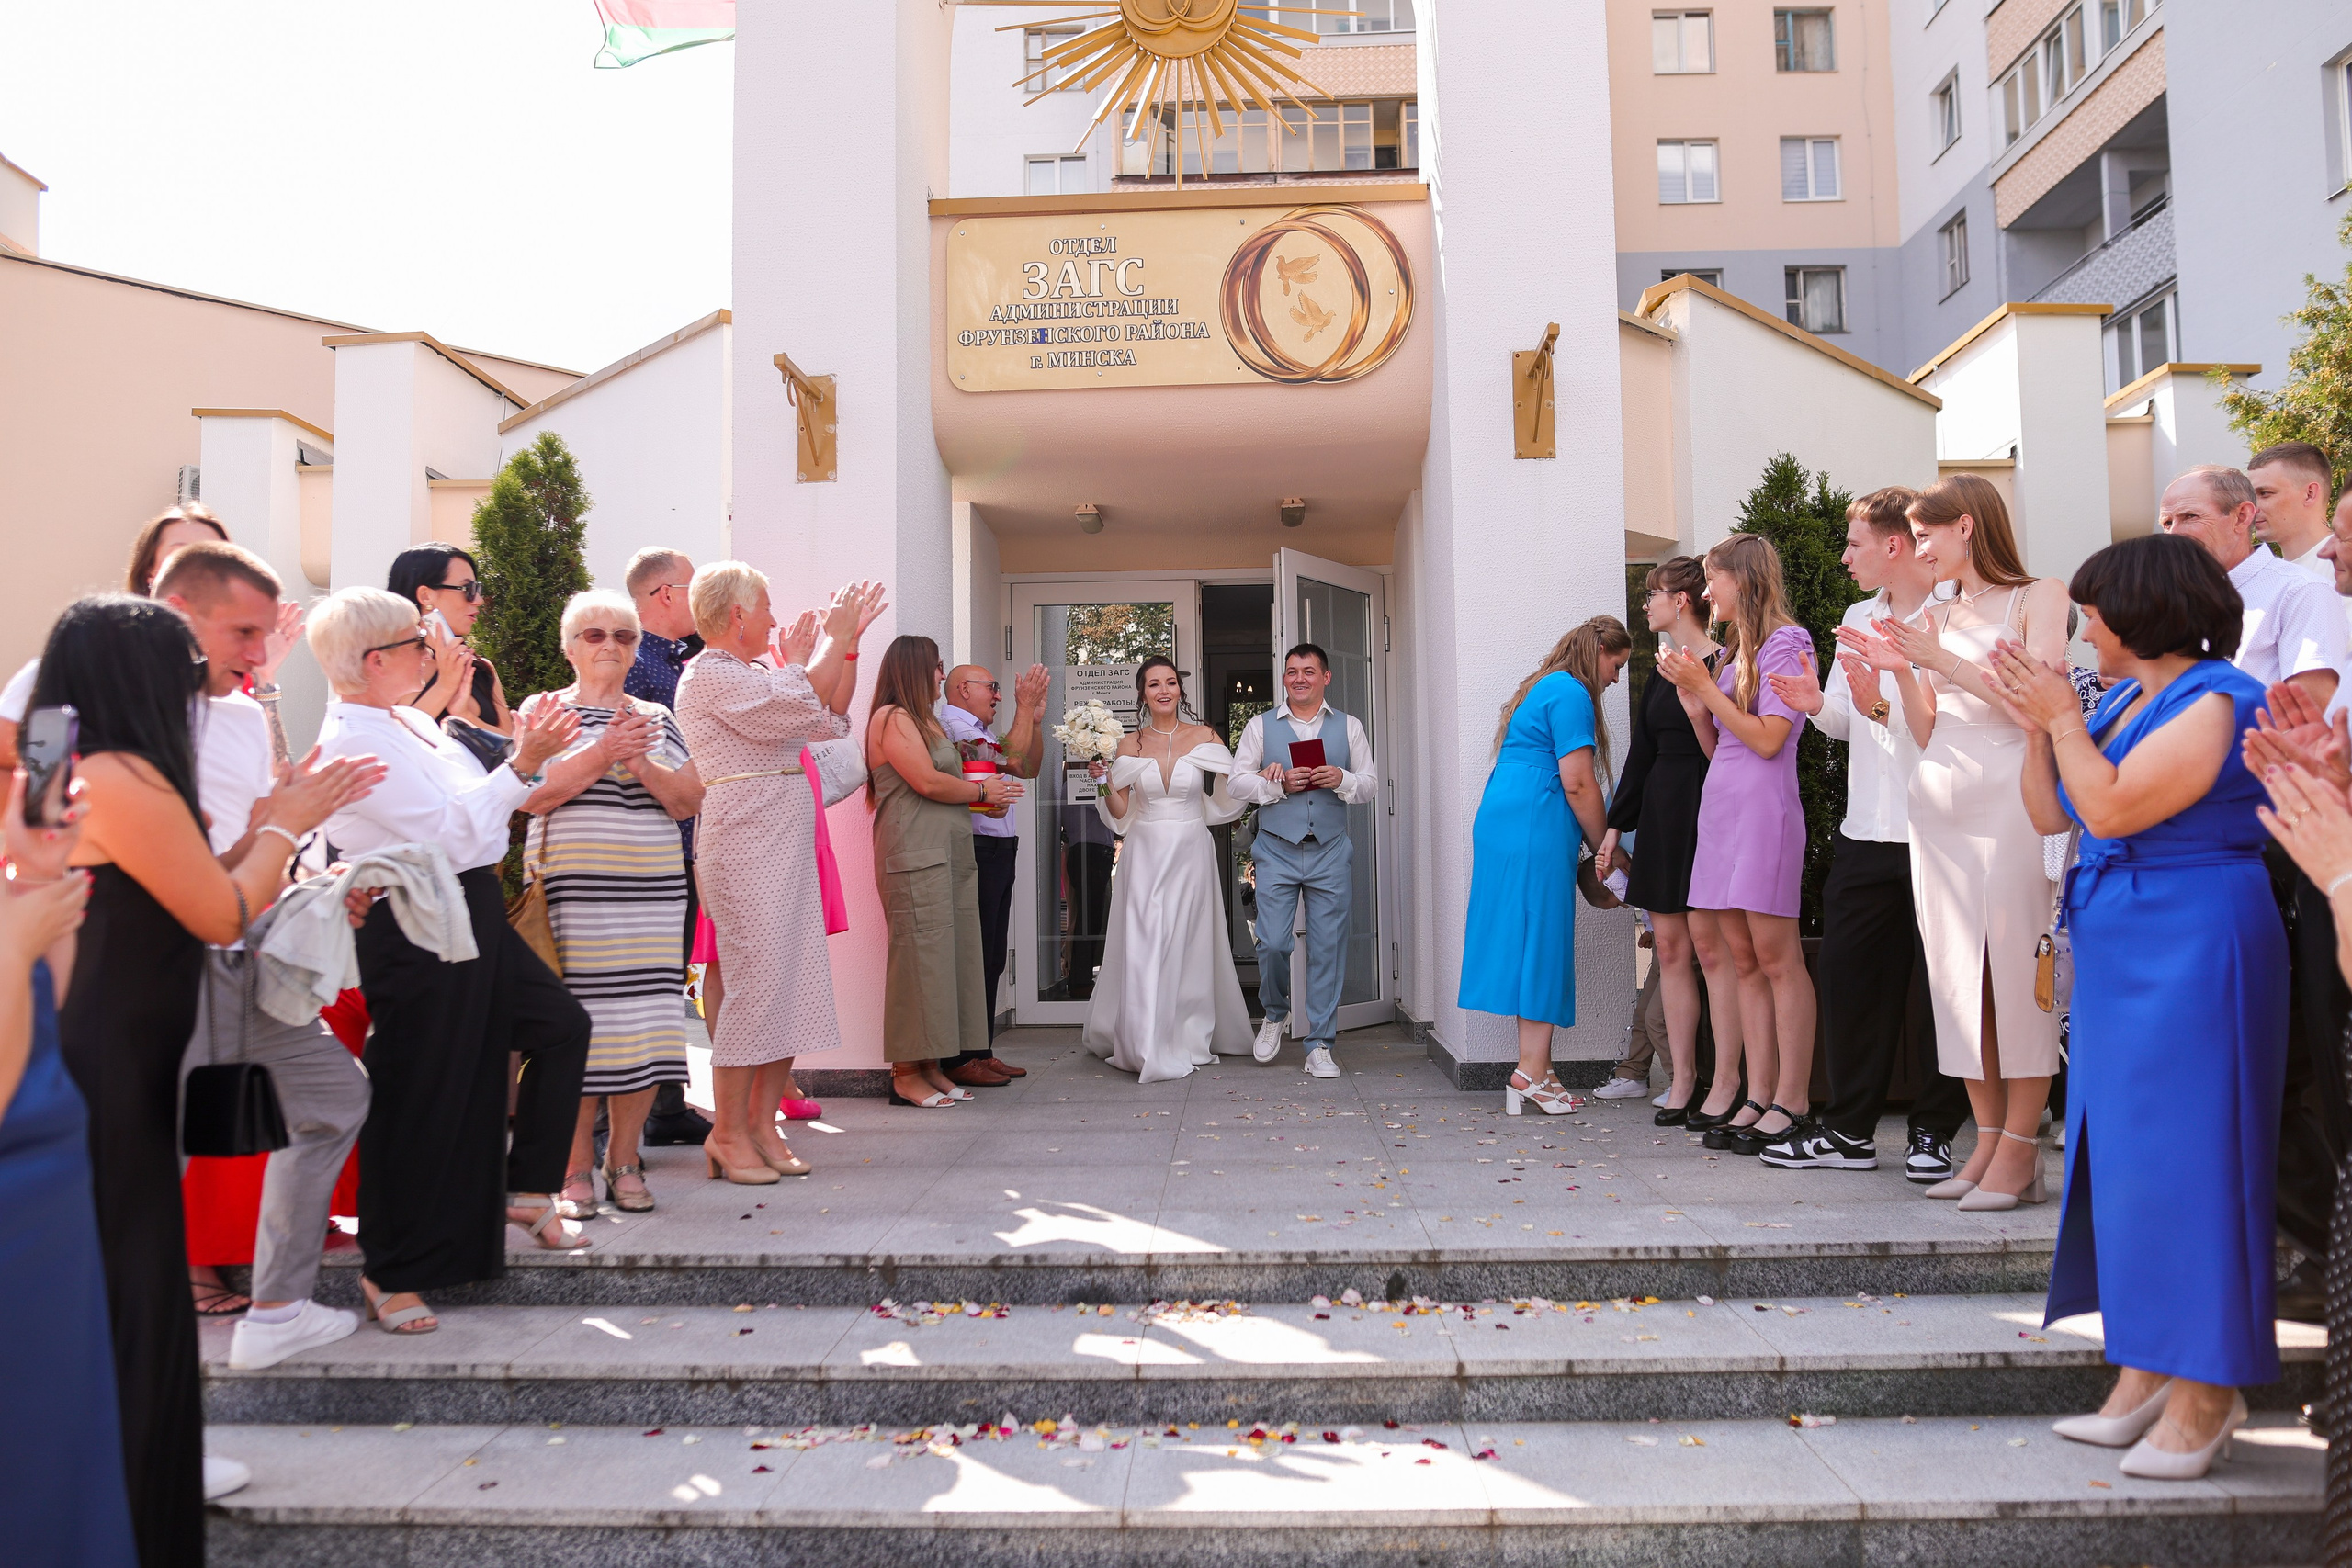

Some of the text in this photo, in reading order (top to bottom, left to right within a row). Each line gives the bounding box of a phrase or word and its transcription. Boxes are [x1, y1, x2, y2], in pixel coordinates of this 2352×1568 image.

[1049, 237, 1117, 257] ОТДЕЛ
[1023, 258, 1144, 299] ЗАГС
[989, 299, 1179, 324] АДМИНИСТРАЦИИ
[957, 320, 1210, 346] ФРУНЗЕНСКОГО РАЙОНА
[1030, 349, 1137, 368] г. МИНСКА
[1077, 670, 1106, 678] ОТДЕЛ
